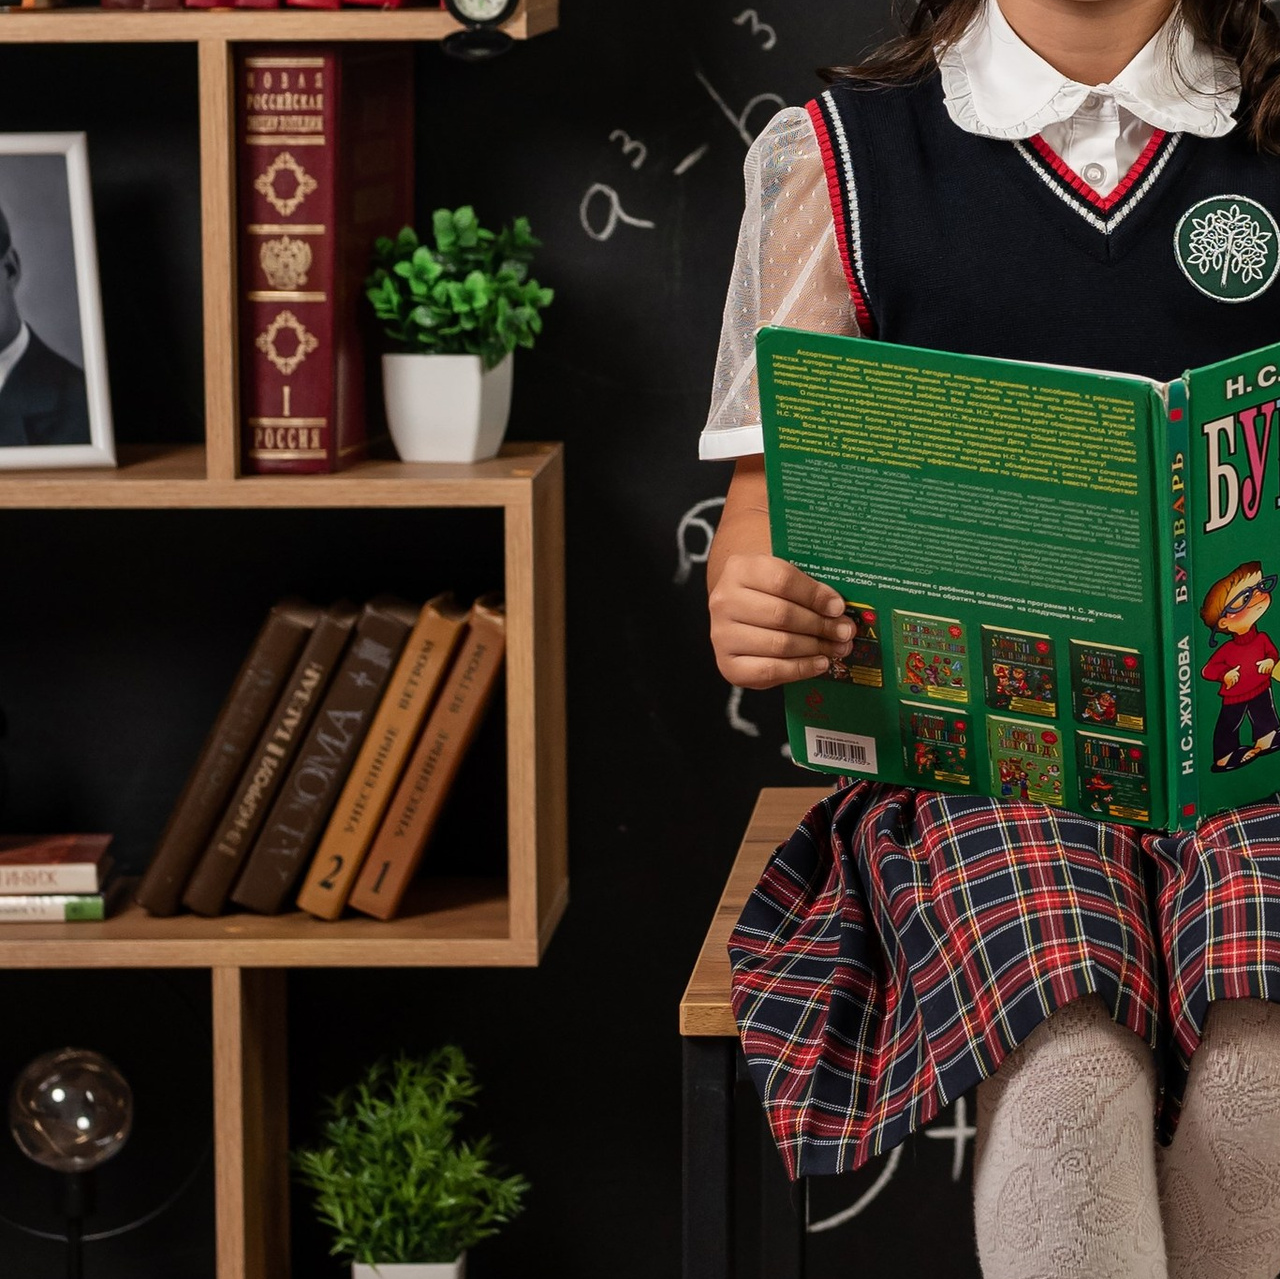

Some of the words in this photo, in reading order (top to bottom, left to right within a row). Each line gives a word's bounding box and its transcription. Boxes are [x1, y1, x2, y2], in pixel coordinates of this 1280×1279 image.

[246, 91, 324, 111] РОССИЙСКАЯ
[1226, 377, 1253, 400] Н.
[253, 427, 321, 450] РОССИЯ
[1171, 452, 1190, 604] БУКВАРЬ
[809, 562, 820, 571] вы
[821, 564, 853, 576] захотите
[854, 569, 900, 584] продолжить
[902, 577, 931, 589] занятия
[986, 591, 1025, 605] авторской
[1027, 598, 1066, 611] программе
[1087, 608, 1123, 621] Жуковой,
[1175, 635, 1194, 728] ЖУКОВА
[1179, 728, 1194, 752] С.
[1180, 752, 1195, 776] Н.
